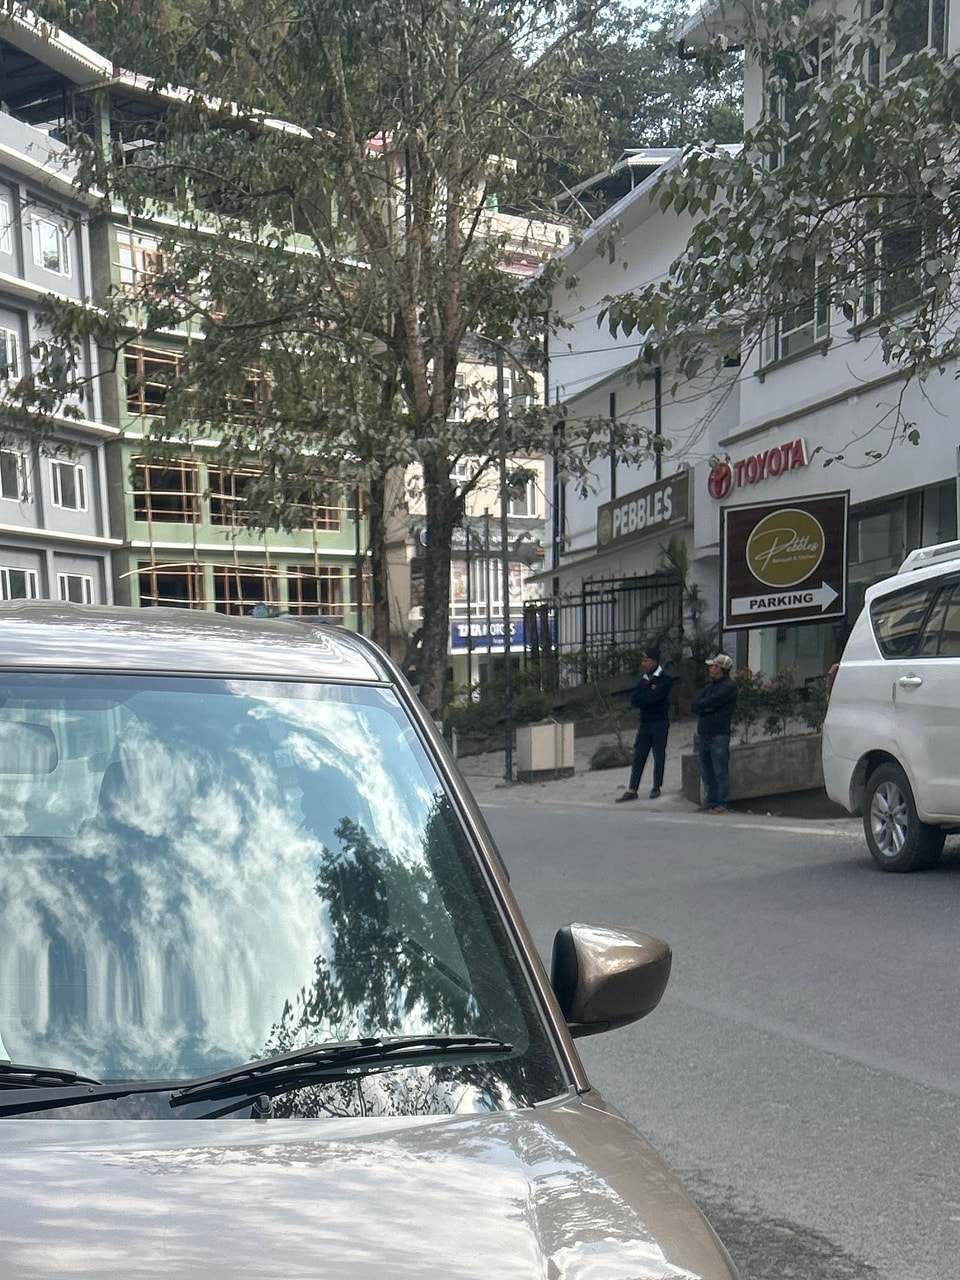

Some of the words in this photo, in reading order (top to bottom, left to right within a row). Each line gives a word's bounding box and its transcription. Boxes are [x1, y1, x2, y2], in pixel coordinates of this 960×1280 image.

[734, 438, 807, 488] TOYOTA
[613, 486, 672, 539] PEBBLES
[751, 528, 818, 571] Pebbles
[749, 593, 814, 610] PARKING
[482, 622, 516, 636] OTOS
